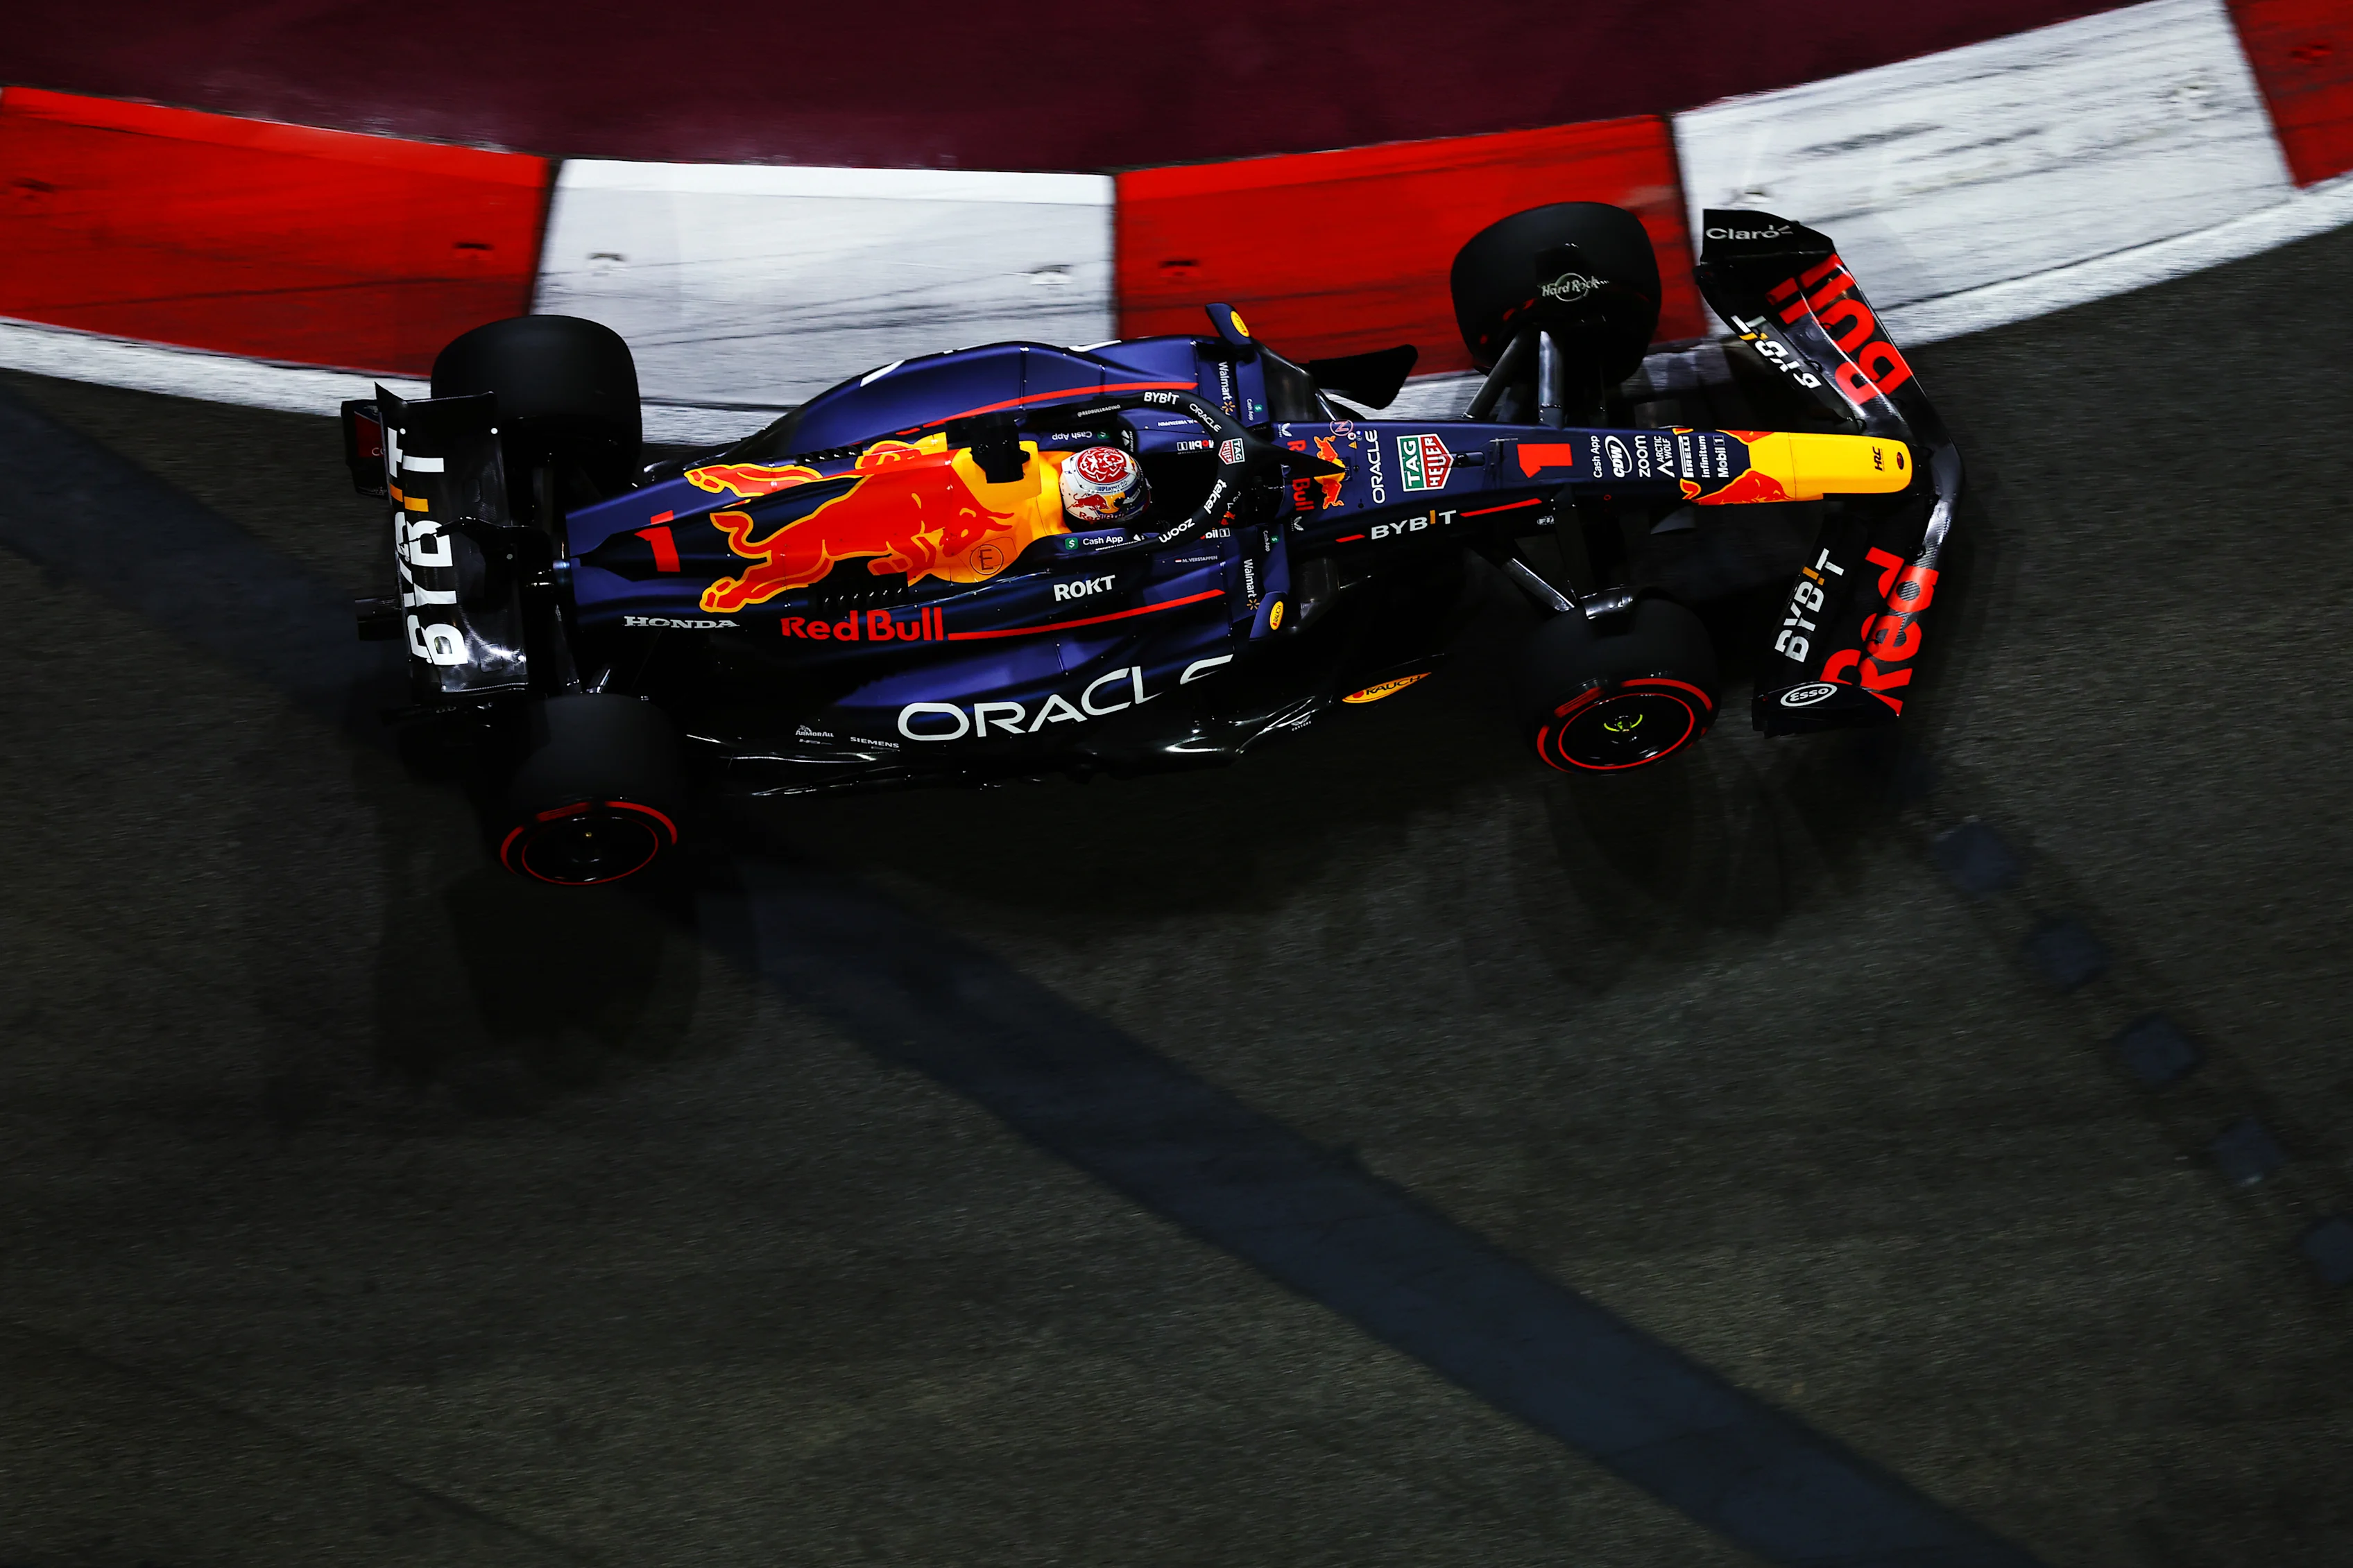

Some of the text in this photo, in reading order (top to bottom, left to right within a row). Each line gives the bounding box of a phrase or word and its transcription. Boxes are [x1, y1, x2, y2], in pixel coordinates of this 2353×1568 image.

[1706, 226, 1780, 240] Claro
[1541, 275, 1599, 297] Hard Rock
[1766, 252, 1914, 406] Bull
[1731, 315, 1822, 389] BYBIT
[1218, 361, 1233, 401] Walmart
[1144, 392, 1180, 405] BYBIT
[1190, 403, 1222, 432] ORACLE
[1222, 442, 1233, 463] HEUER
[1234, 440, 1242, 460] TAG
[1403, 440, 1421, 487] TAG
[1424, 437, 1447, 486] HEUER
[1517, 443, 1573, 478] 1
[1591, 436, 1603, 478] Cash App
[1610, 445, 1625, 477] CDW
[1634, 436, 1651, 477] zoom
[1653, 436, 1665, 463] ARCTIC
[1662, 438, 1672, 459] WOLF
[1678, 436, 1694, 478] PIRELLI
[1698, 436, 1710, 478] infinitum
[1714, 447, 1729, 477] Mobil
[1872, 446, 1883, 471] HRC
[1364, 429, 1385, 503] ORACLE
[1204, 479, 1227, 514] telcel
[1292, 478, 1315, 510] Bull
[634, 510, 681, 572] 1
[1083, 536, 1104, 545] Cash
[1106, 535, 1123, 544] App
[1158, 518, 1195, 543] zoom
[1371, 510, 1456, 540] BYBIT
[386, 427, 468, 666] BYBIT
[1054, 574, 1115, 601] ROKT
[1244, 559, 1257, 598] Walmart
[1274, 605, 1282, 622] RAUCH
[1774, 548, 1844, 662] BYBIT
[624, 616, 740, 629] HONDA
[780, 608, 943, 641] Red Bull
[1820, 546, 1940, 717] Red
[850, 736, 899, 748] SIEMENS
